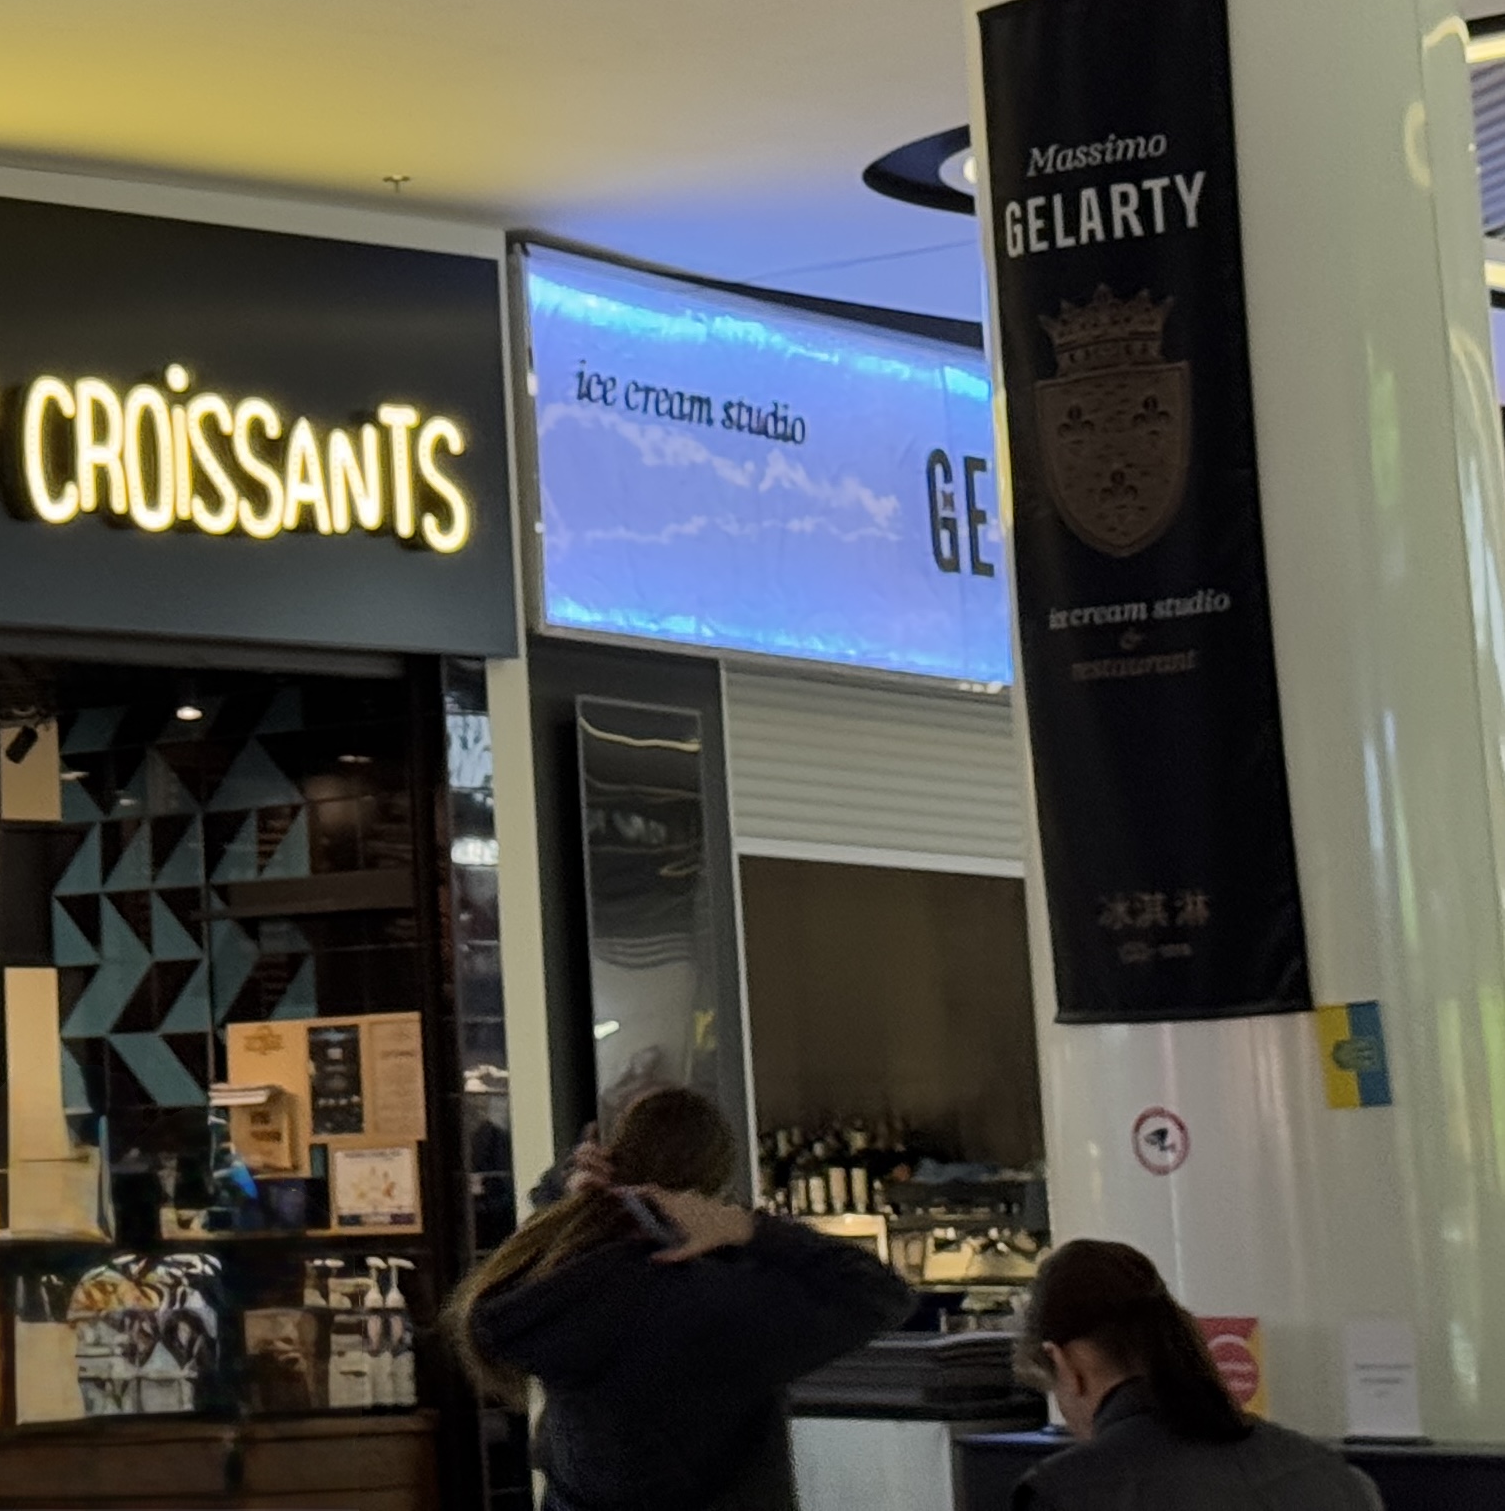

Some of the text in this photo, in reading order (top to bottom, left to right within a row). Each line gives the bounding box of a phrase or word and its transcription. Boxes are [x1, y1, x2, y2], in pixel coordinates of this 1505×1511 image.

[1027, 133, 1168, 177] Massimo
[1005, 171, 1206, 258] GELARTY
[576, 359, 806, 444] ice cream studio
